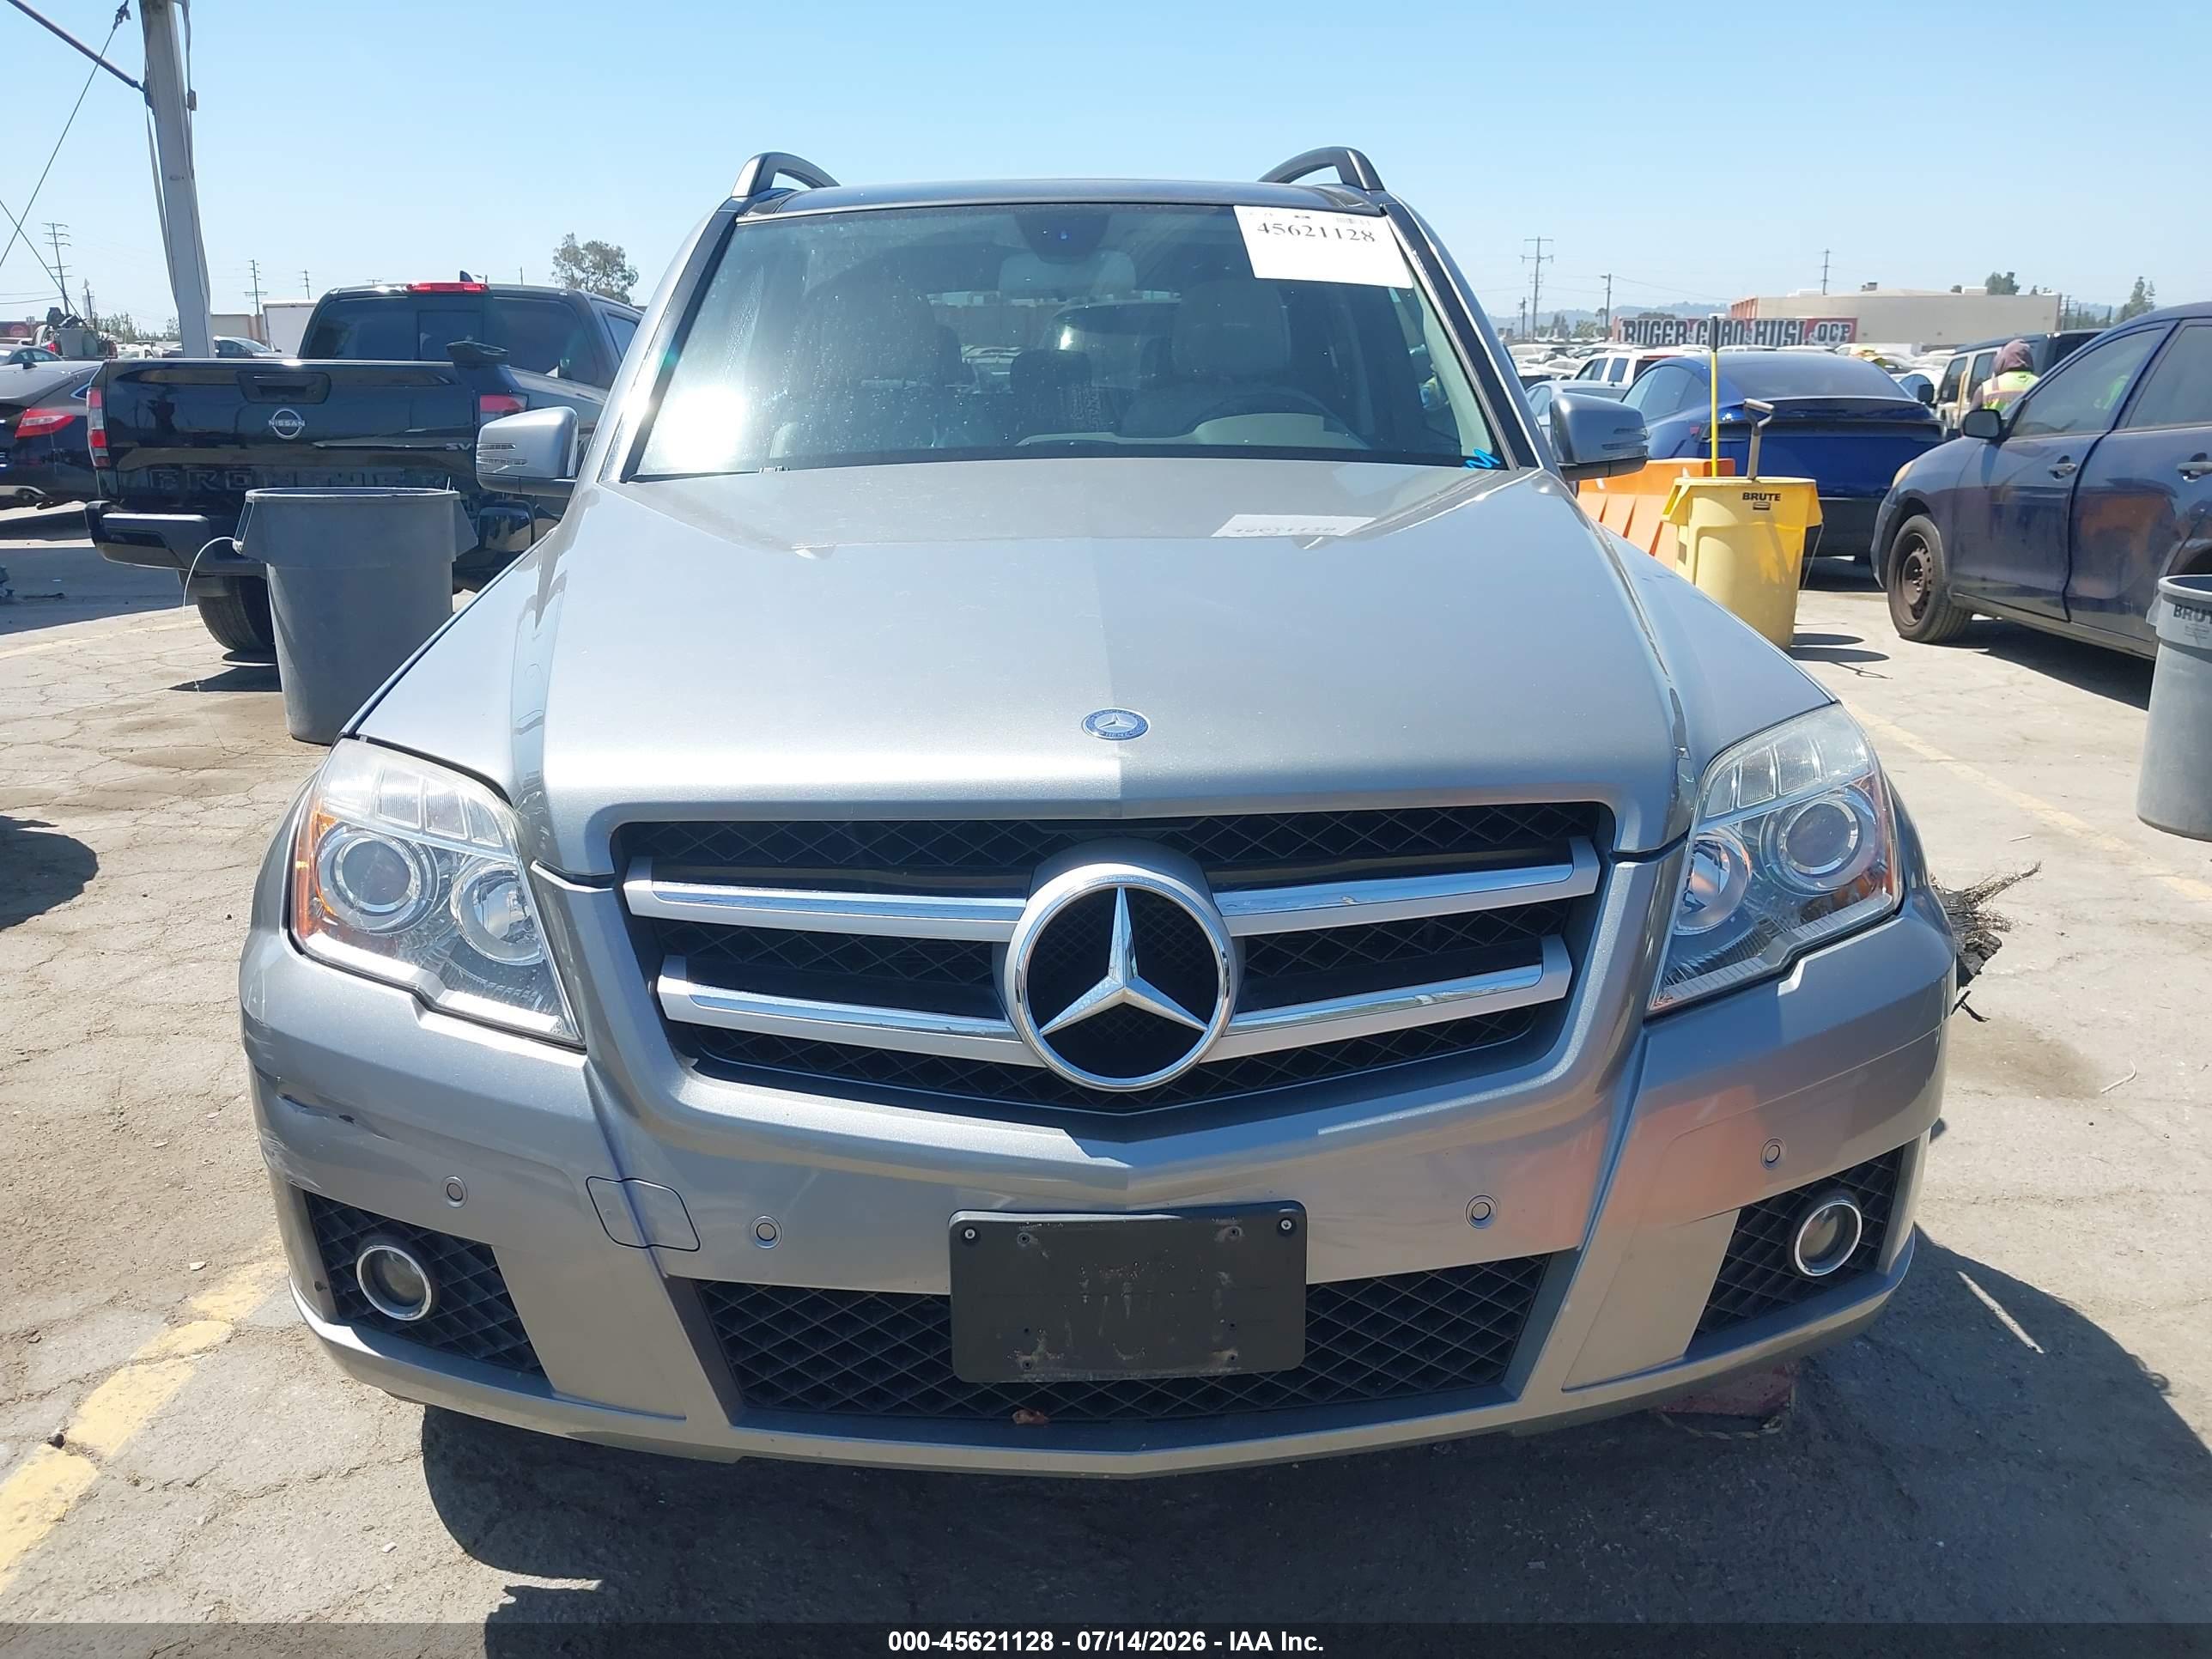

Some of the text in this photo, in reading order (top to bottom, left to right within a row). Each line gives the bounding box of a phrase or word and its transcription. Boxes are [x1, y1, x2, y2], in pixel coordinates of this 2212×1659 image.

[1257, 222, 1376, 242] 45621128
[446, 442, 472, 451] SV
[1741, 492, 1782, 501] BRUTE
